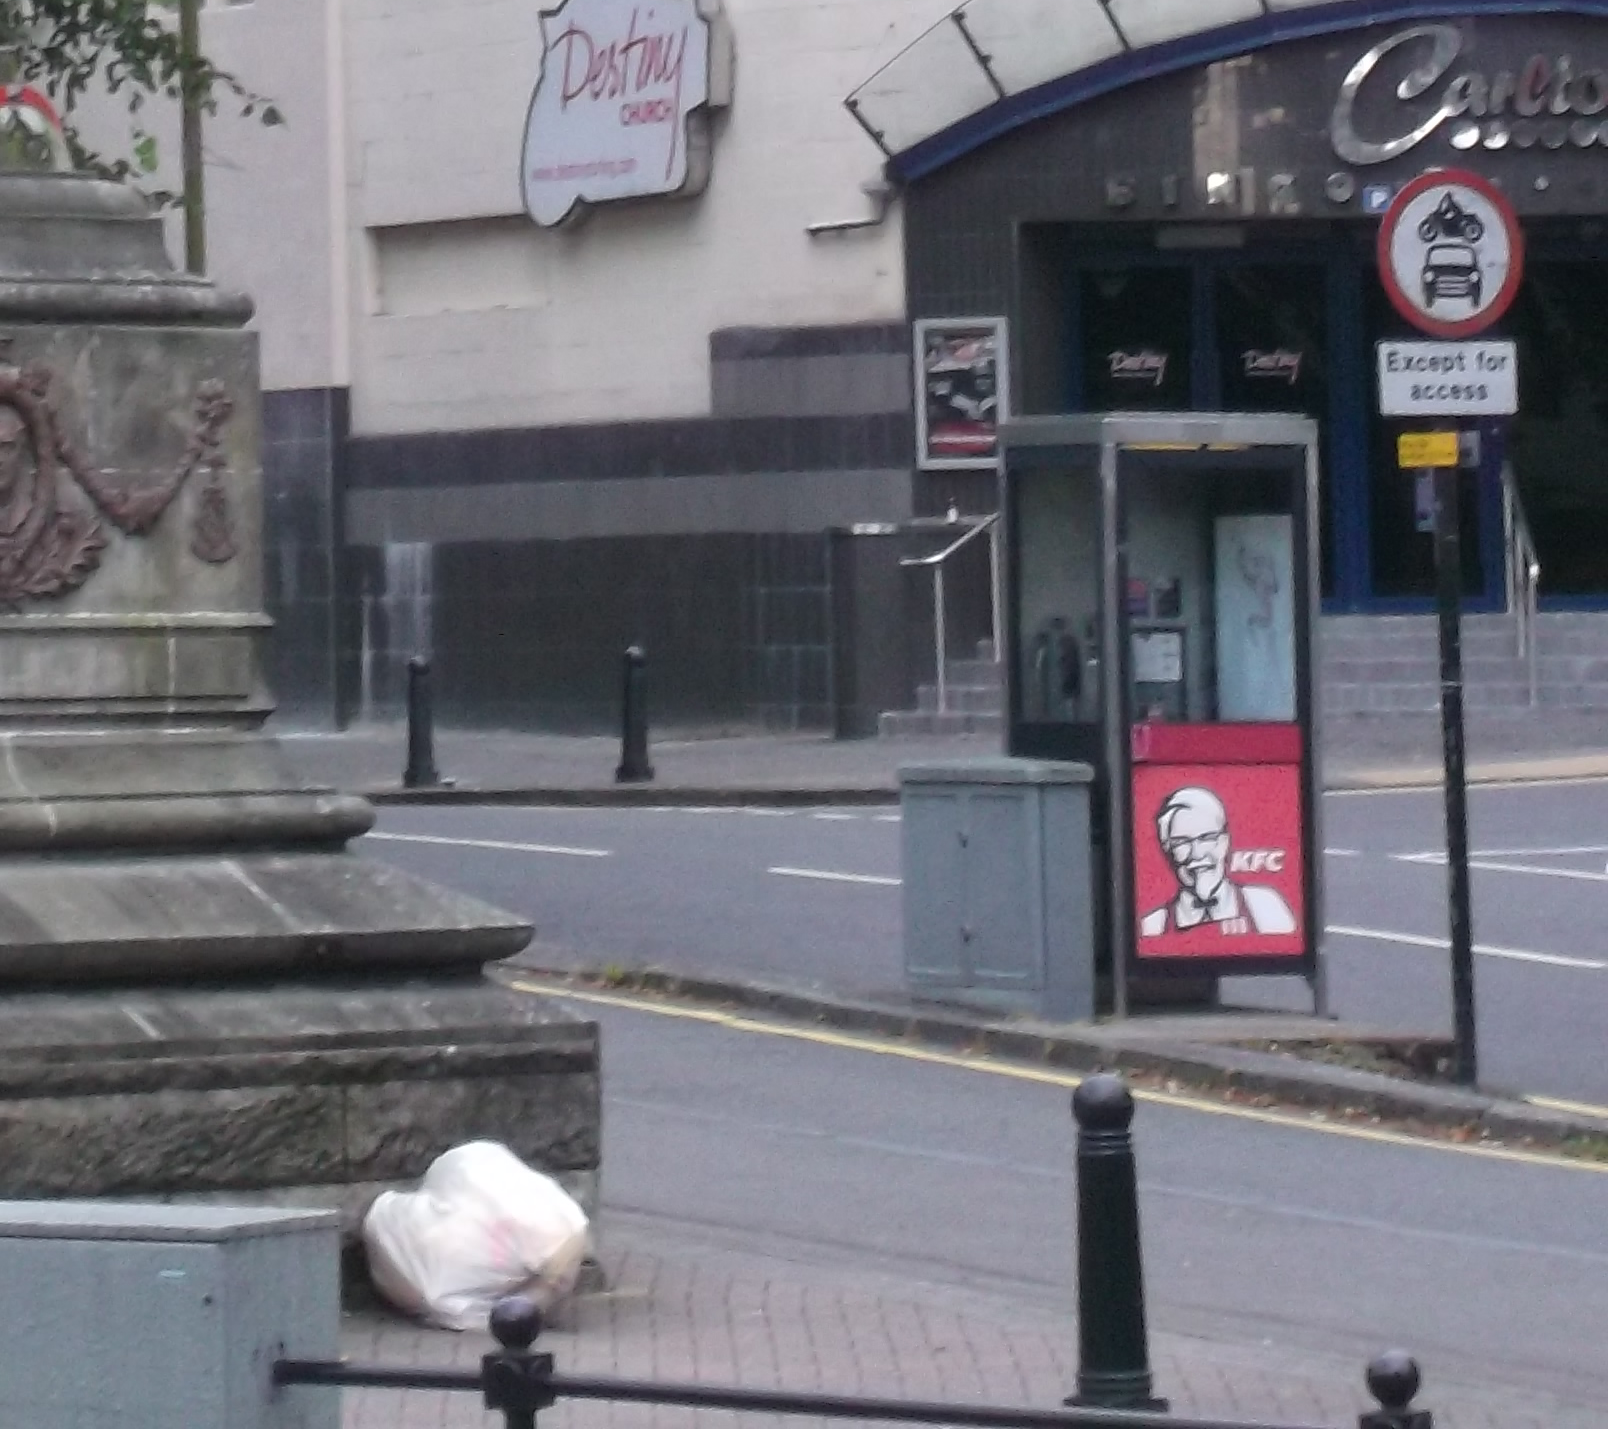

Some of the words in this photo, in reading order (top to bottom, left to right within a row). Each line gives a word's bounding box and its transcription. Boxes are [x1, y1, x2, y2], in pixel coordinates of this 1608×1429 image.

[549, 7, 689, 182] Destiny
[1386, 349, 1466, 375] Except
[1474, 349, 1507, 372] for
[1410, 383, 1489, 401] access
[1229, 849, 1287, 873] KFC
